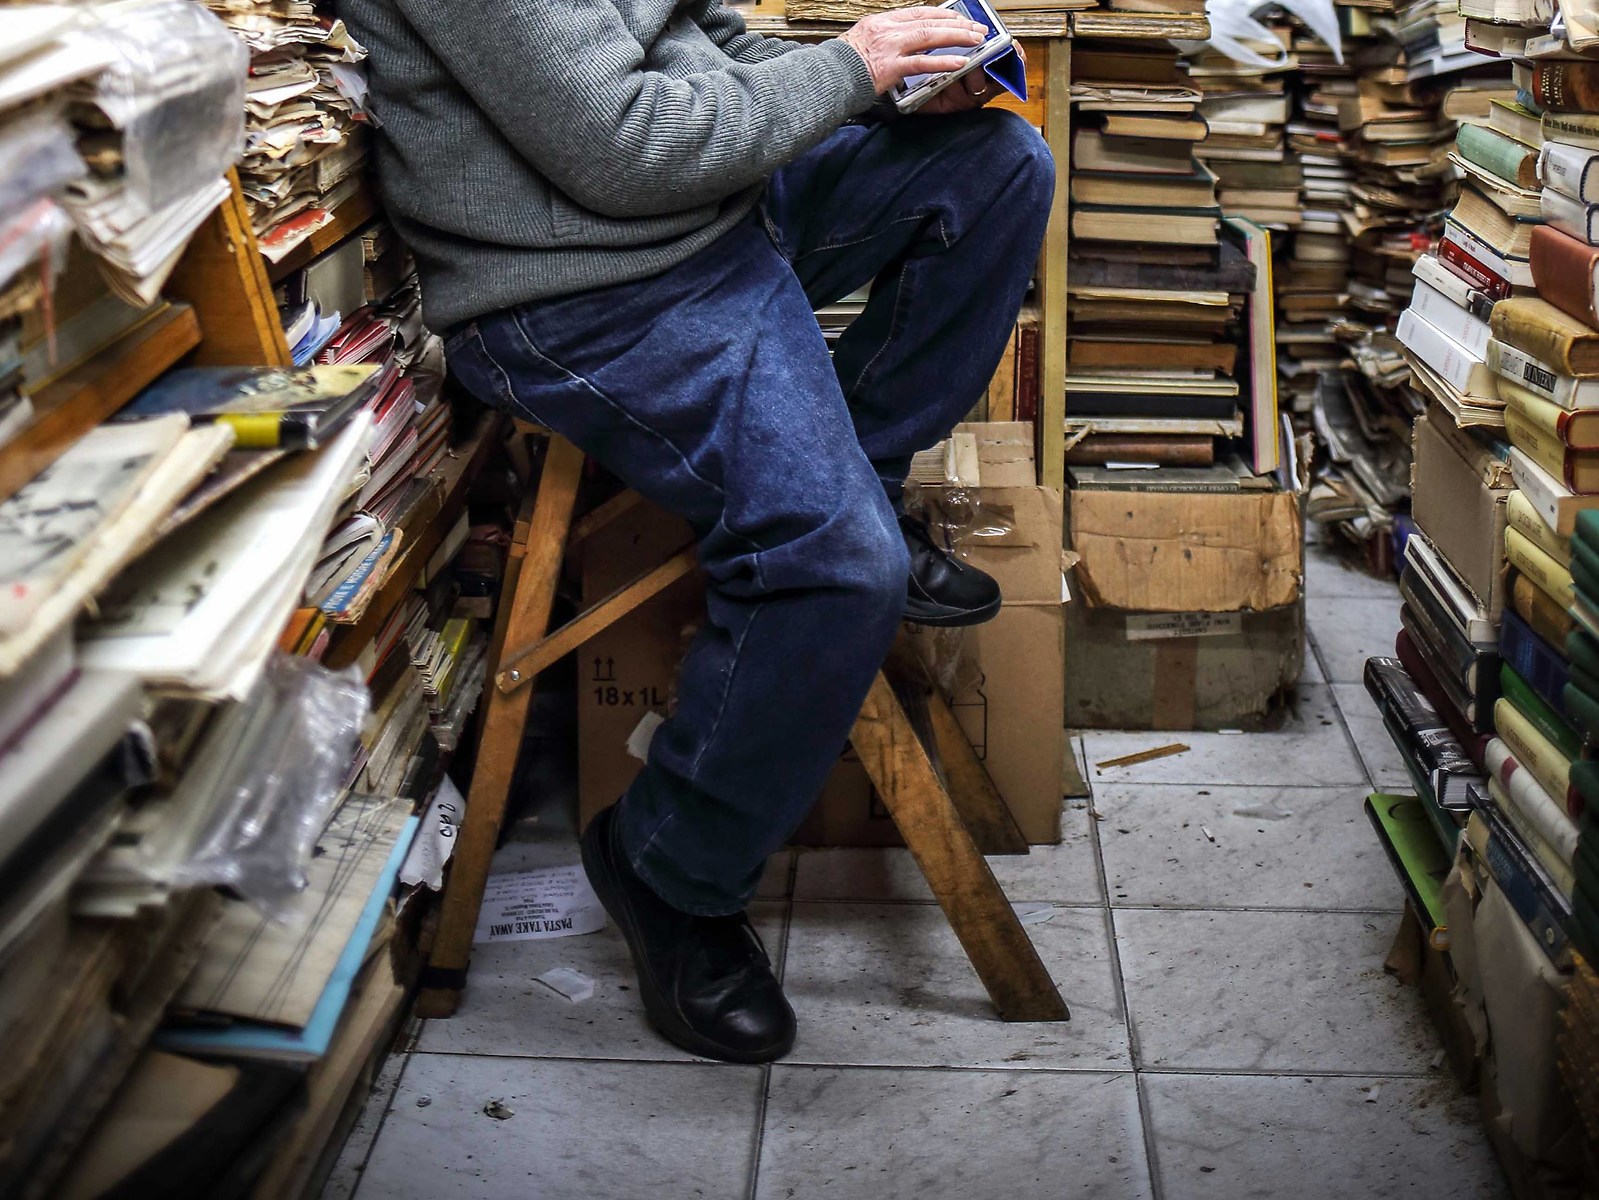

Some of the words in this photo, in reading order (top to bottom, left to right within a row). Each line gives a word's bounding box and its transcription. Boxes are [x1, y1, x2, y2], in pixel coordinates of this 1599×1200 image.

[594, 687, 619, 706] 18
[622, 691, 634, 706] x
[639, 687, 667, 706] 1L
[490, 924, 512, 937] AWAY
[516, 920, 542, 934] TAKE
[543, 917, 573, 932] PASTA
